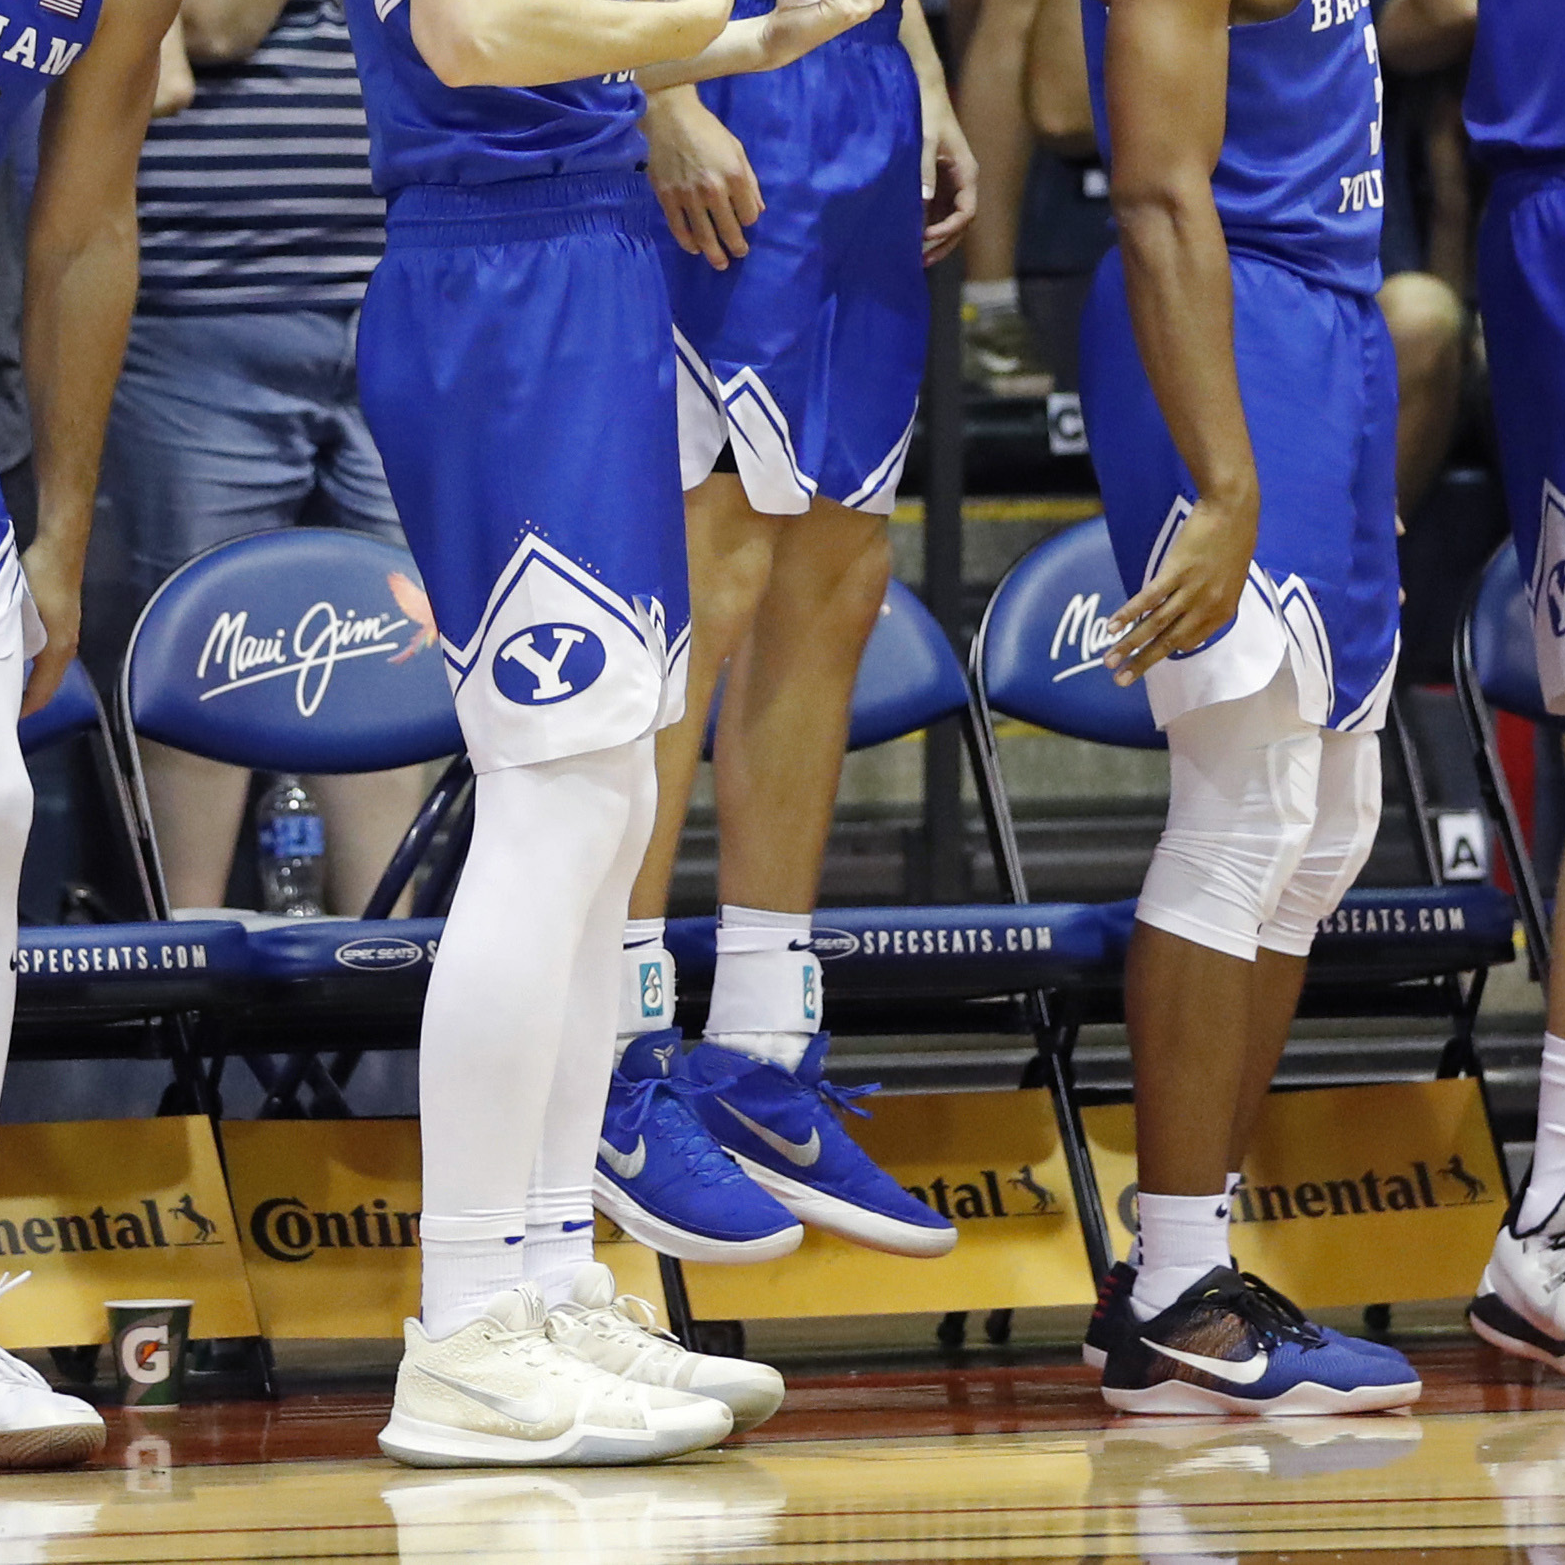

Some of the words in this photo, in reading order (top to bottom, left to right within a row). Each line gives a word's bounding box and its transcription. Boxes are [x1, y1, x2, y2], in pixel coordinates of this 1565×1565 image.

[1338, 169, 1384, 214] YOU
[197, 611, 286, 680] Maui
[293, 601, 409, 717] Jim
[500, 627, 586, 700] Y
[1451, 836, 1480, 870] A
[863, 926, 1052, 955] SPECSEATS.COM
[1320, 907, 1466, 934] CSEATS.COM
[18, 943, 208, 975] SPECSEATS.COM
[250, 1196, 422, 1263] Contin
[121, 1324, 172, 1384] G
